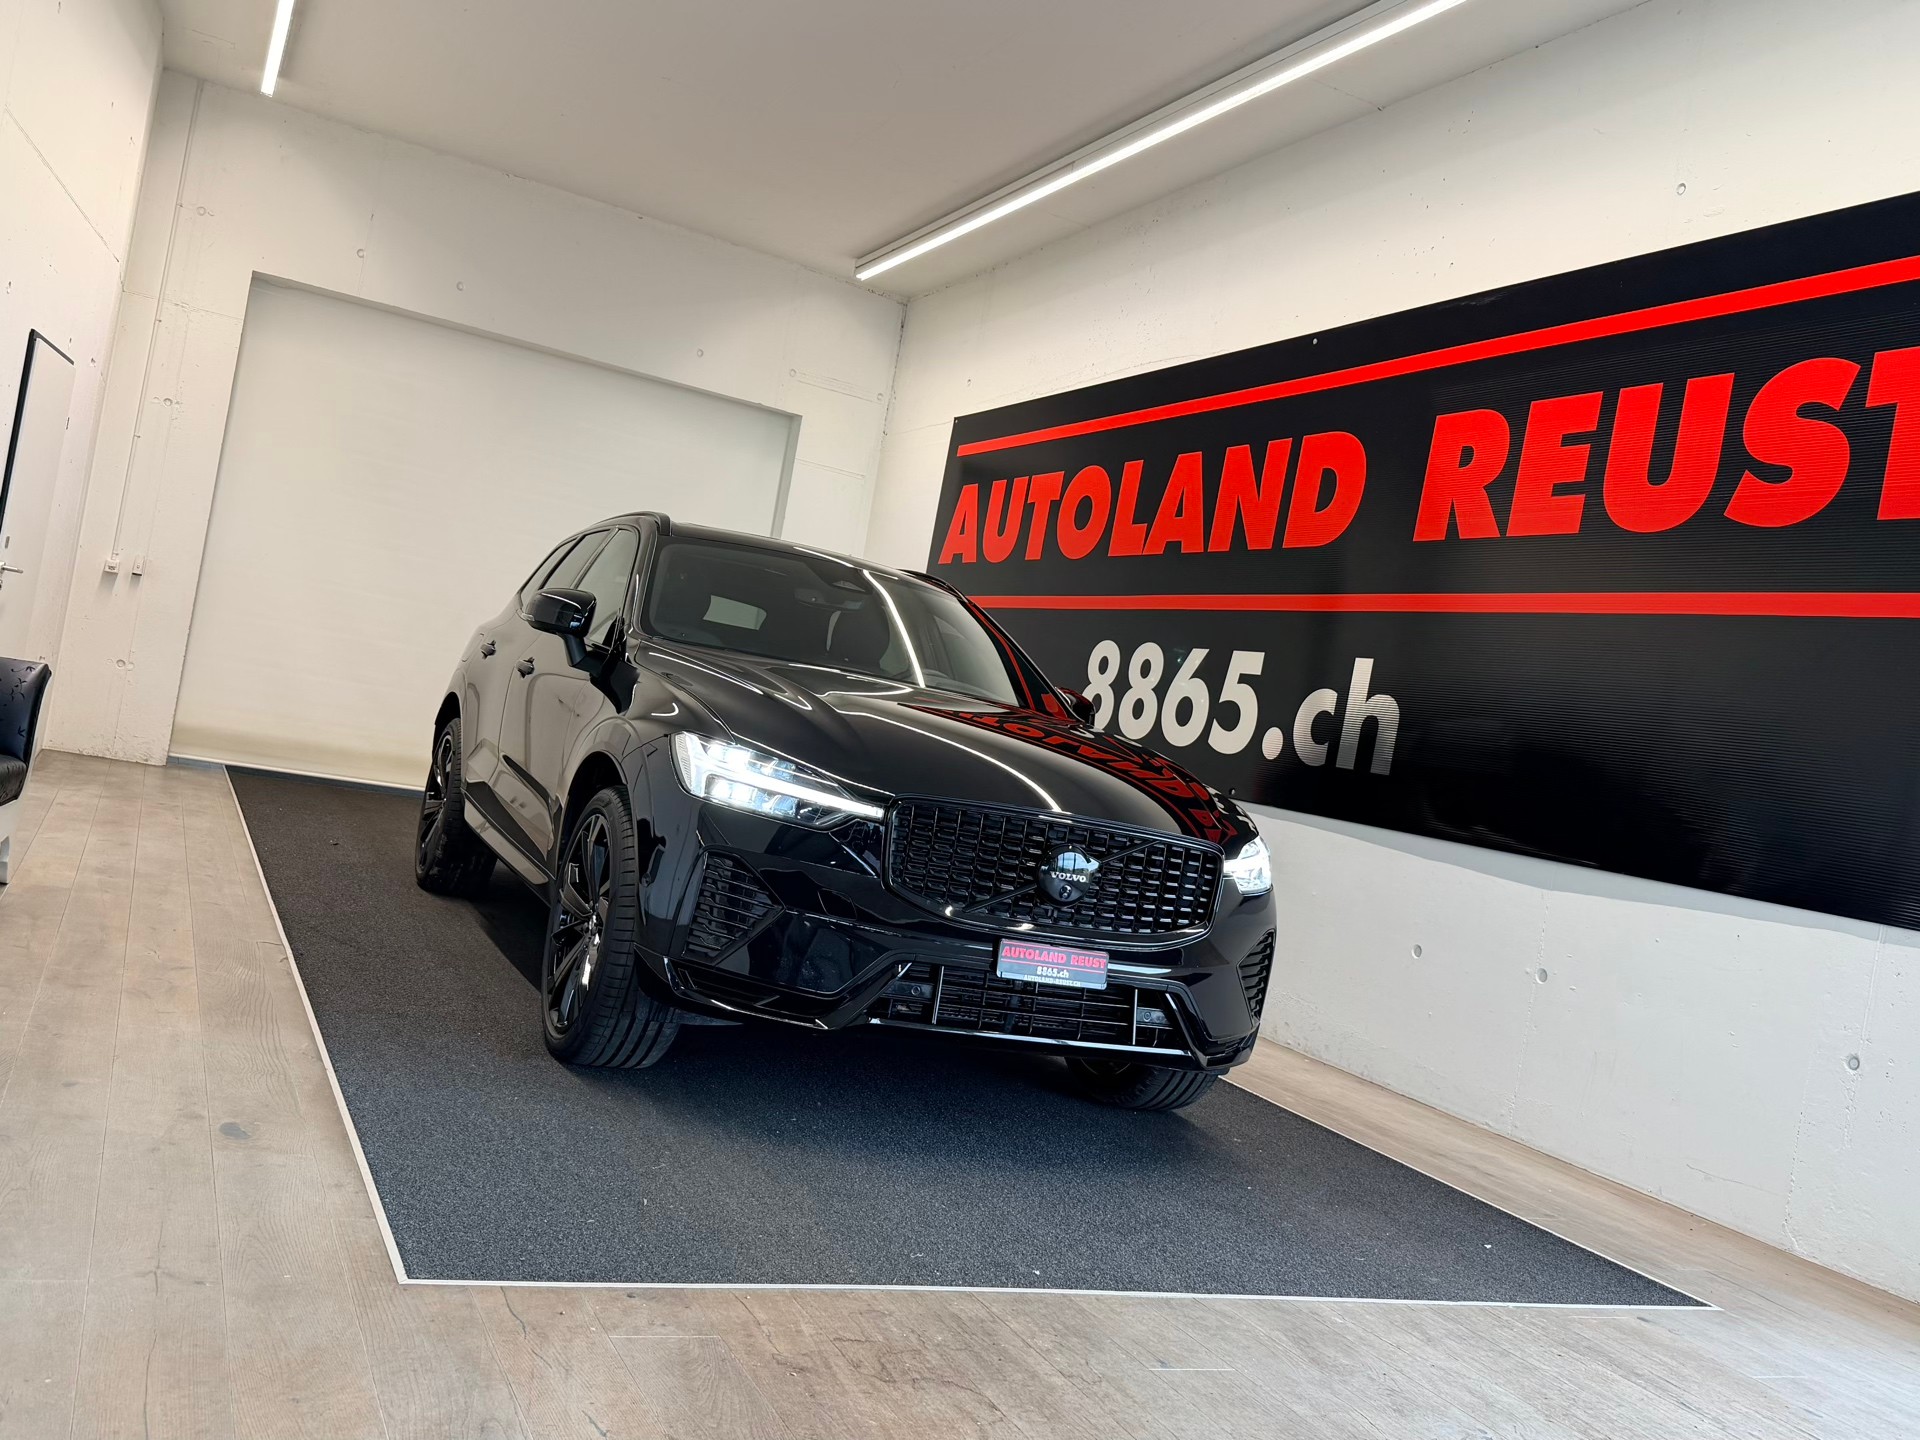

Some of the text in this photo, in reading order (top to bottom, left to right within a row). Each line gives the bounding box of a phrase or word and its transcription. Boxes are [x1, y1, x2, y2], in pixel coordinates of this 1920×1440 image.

[938, 431, 1367, 564] AUTOLAND
[1081, 639, 1401, 777] 8865.ch
[1050, 871, 1087, 883] VOLVO
[1002, 946, 1107, 969] AUTOLAND REUST
[1036, 966, 1070, 979] 8865.ch
